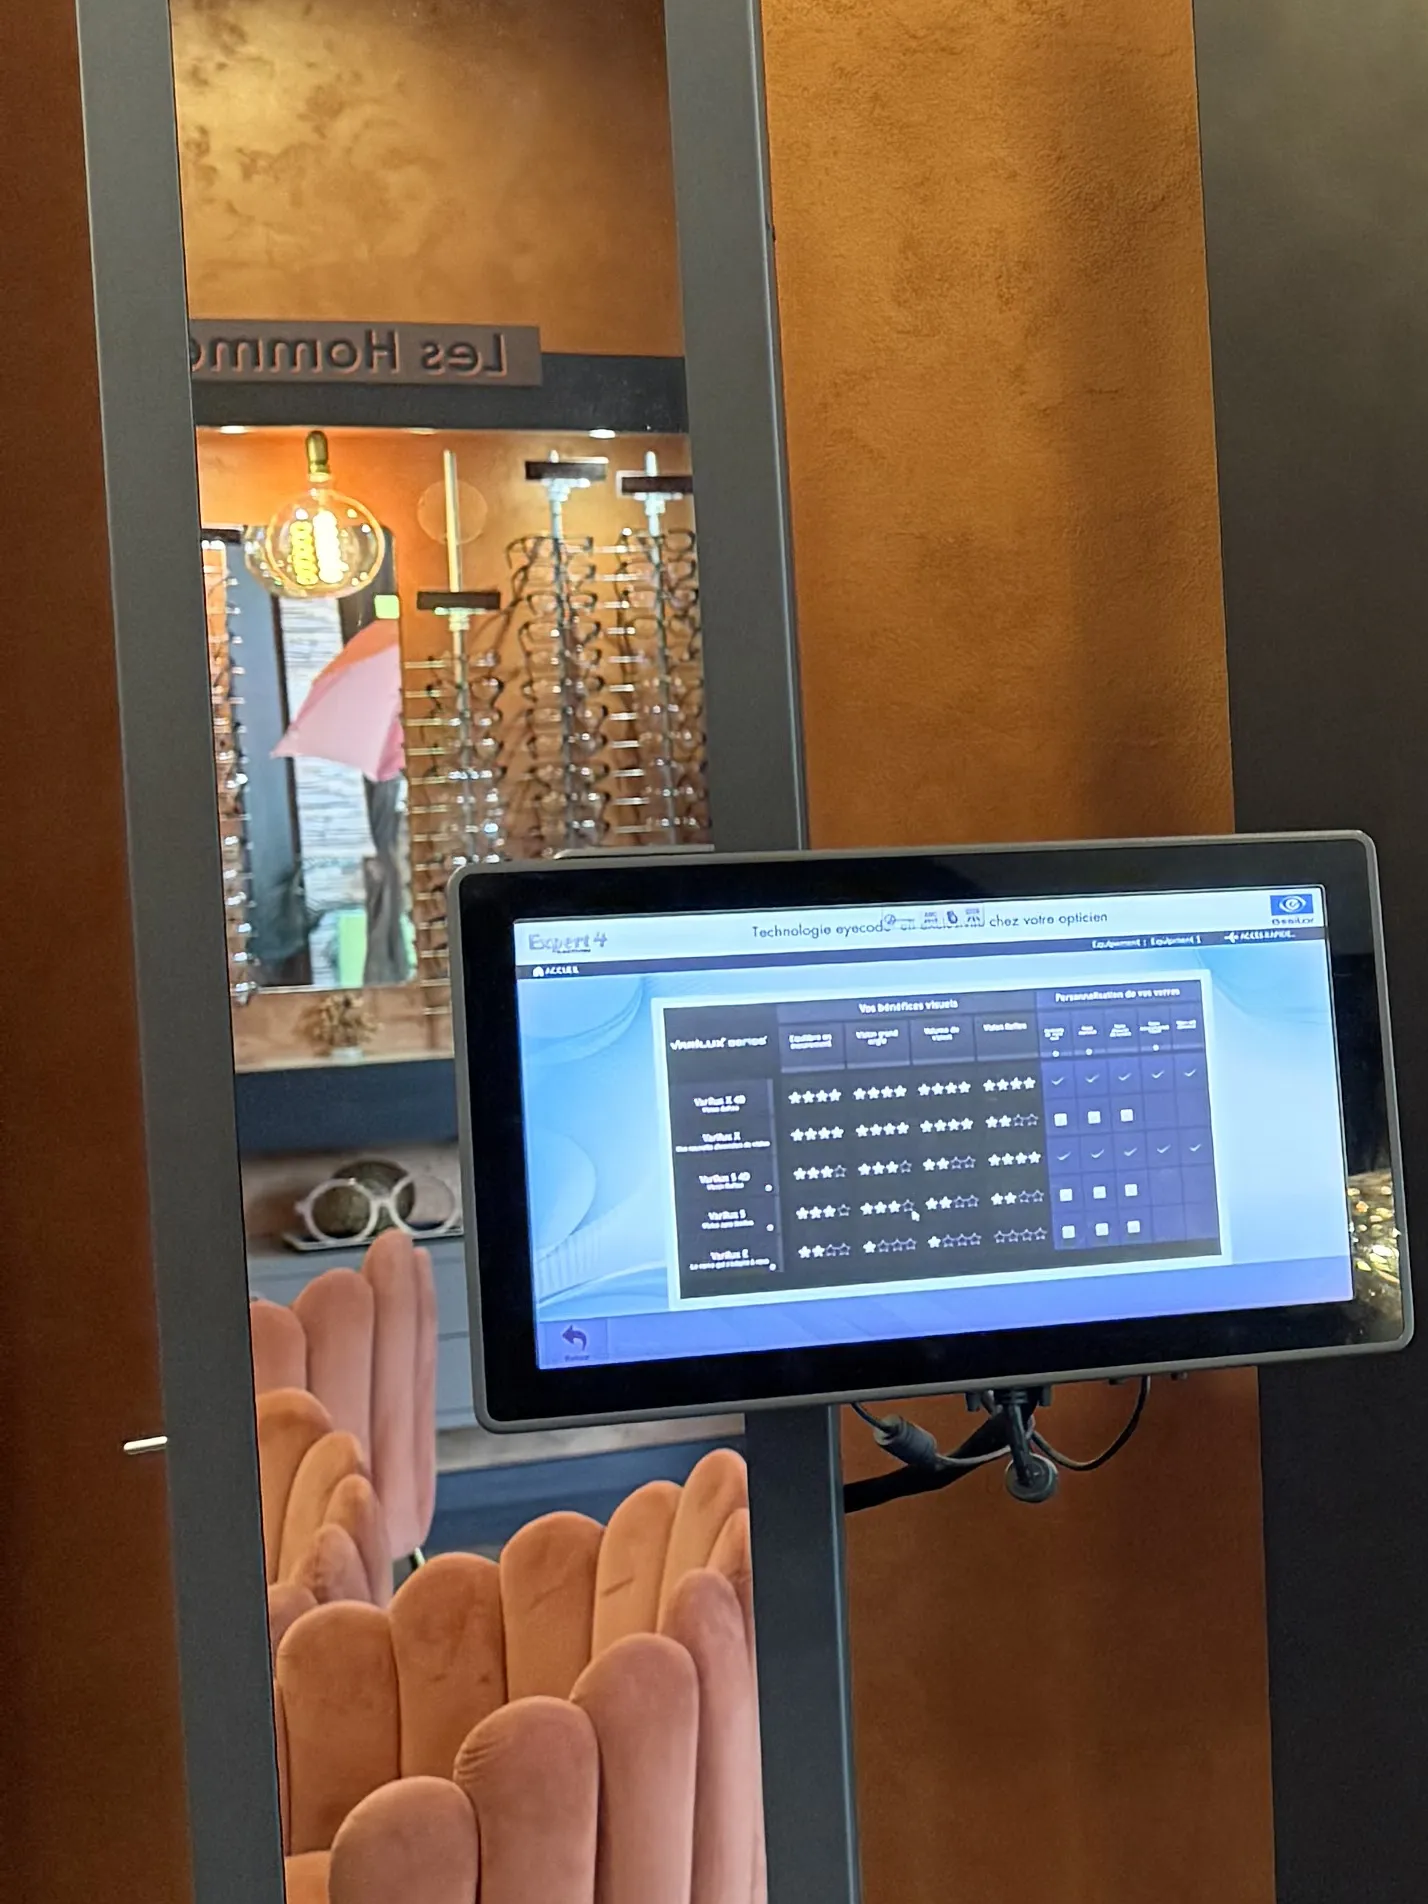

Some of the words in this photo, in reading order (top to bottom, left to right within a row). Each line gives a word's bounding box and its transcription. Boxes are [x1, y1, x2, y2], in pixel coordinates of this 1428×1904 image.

[752, 923, 831, 939] Technologie
[988, 914, 1019, 927] chez
[1023, 913, 1055, 925] votre
[1058, 911, 1108, 929] opticien
[528, 933, 590, 953] Expert
[594, 931, 608, 947] 4
